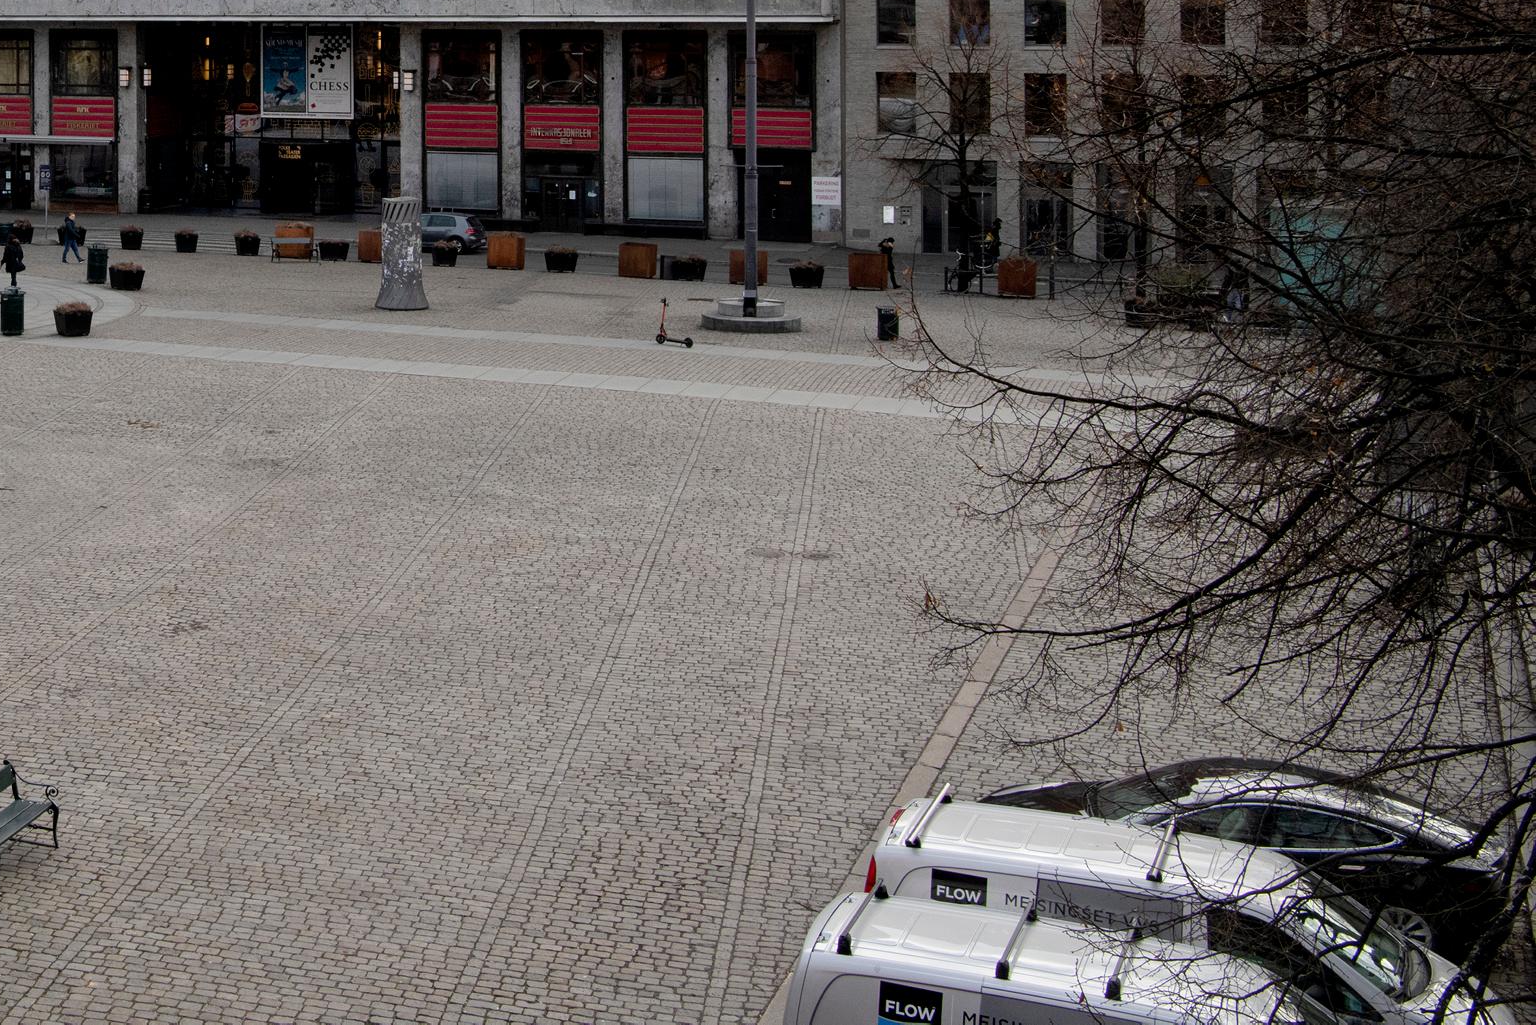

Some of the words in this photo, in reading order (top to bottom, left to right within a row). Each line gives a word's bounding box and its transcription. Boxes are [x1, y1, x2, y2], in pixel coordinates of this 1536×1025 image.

[310, 82, 349, 91] CHESS
[936, 884, 982, 904] FLOW
[1005, 893, 1114, 926] MEISINGSET
[885, 1000, 936, 1022] FLOW
